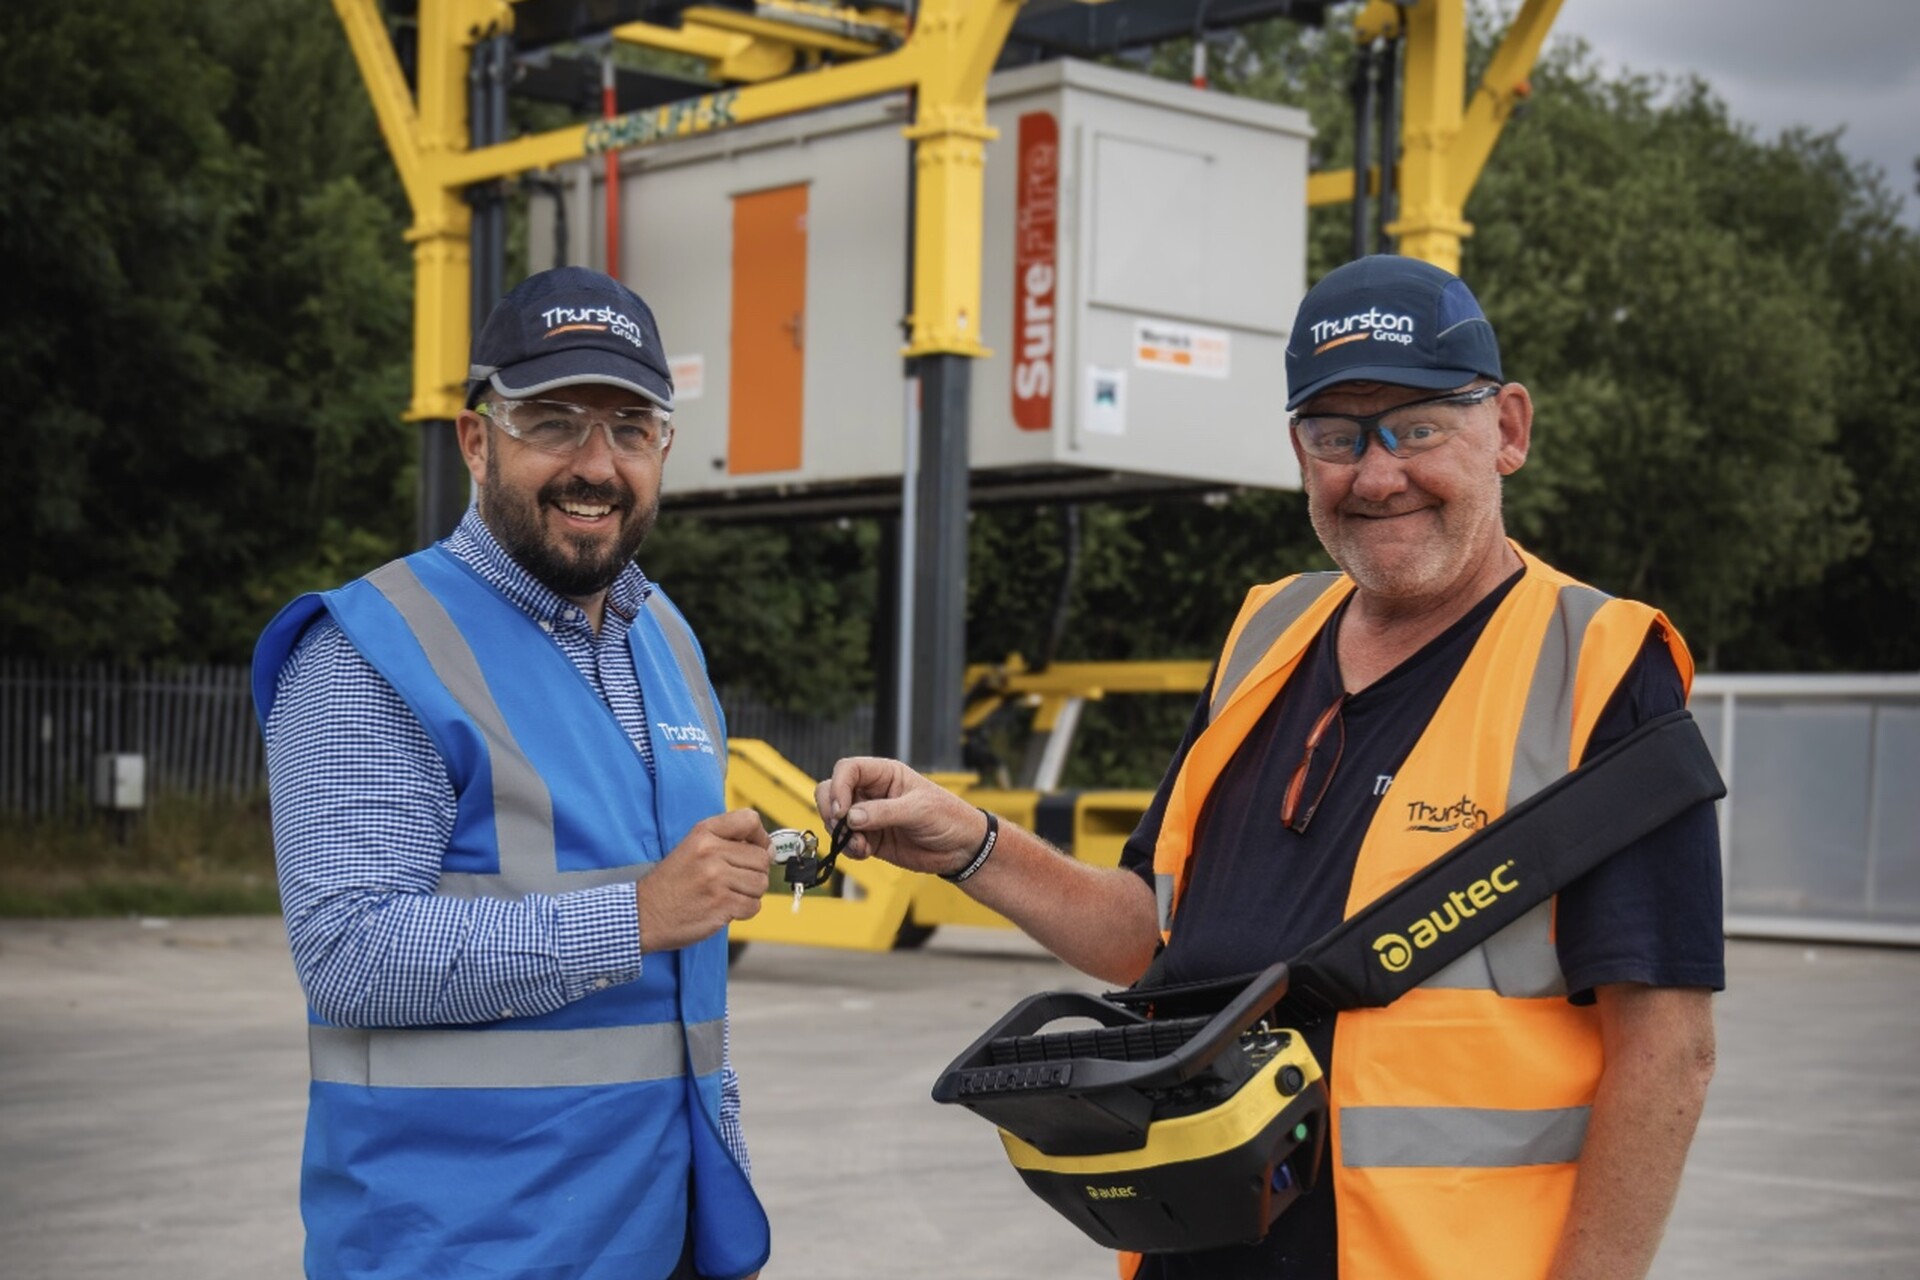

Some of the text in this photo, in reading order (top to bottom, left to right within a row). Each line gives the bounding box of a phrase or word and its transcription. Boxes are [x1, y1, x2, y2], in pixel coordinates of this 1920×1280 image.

[541, 305, 642, 338] Thurston
[1310, 306, 1414, 344] Thurston
[611, 325, 643, 348] Group
[1373, 329, 1413, 346] Group
[1372, 774, 1394, 796] Th
[1407, 862, 1520, 950] autec
[1099, 1185, 1138, 1200] autec
